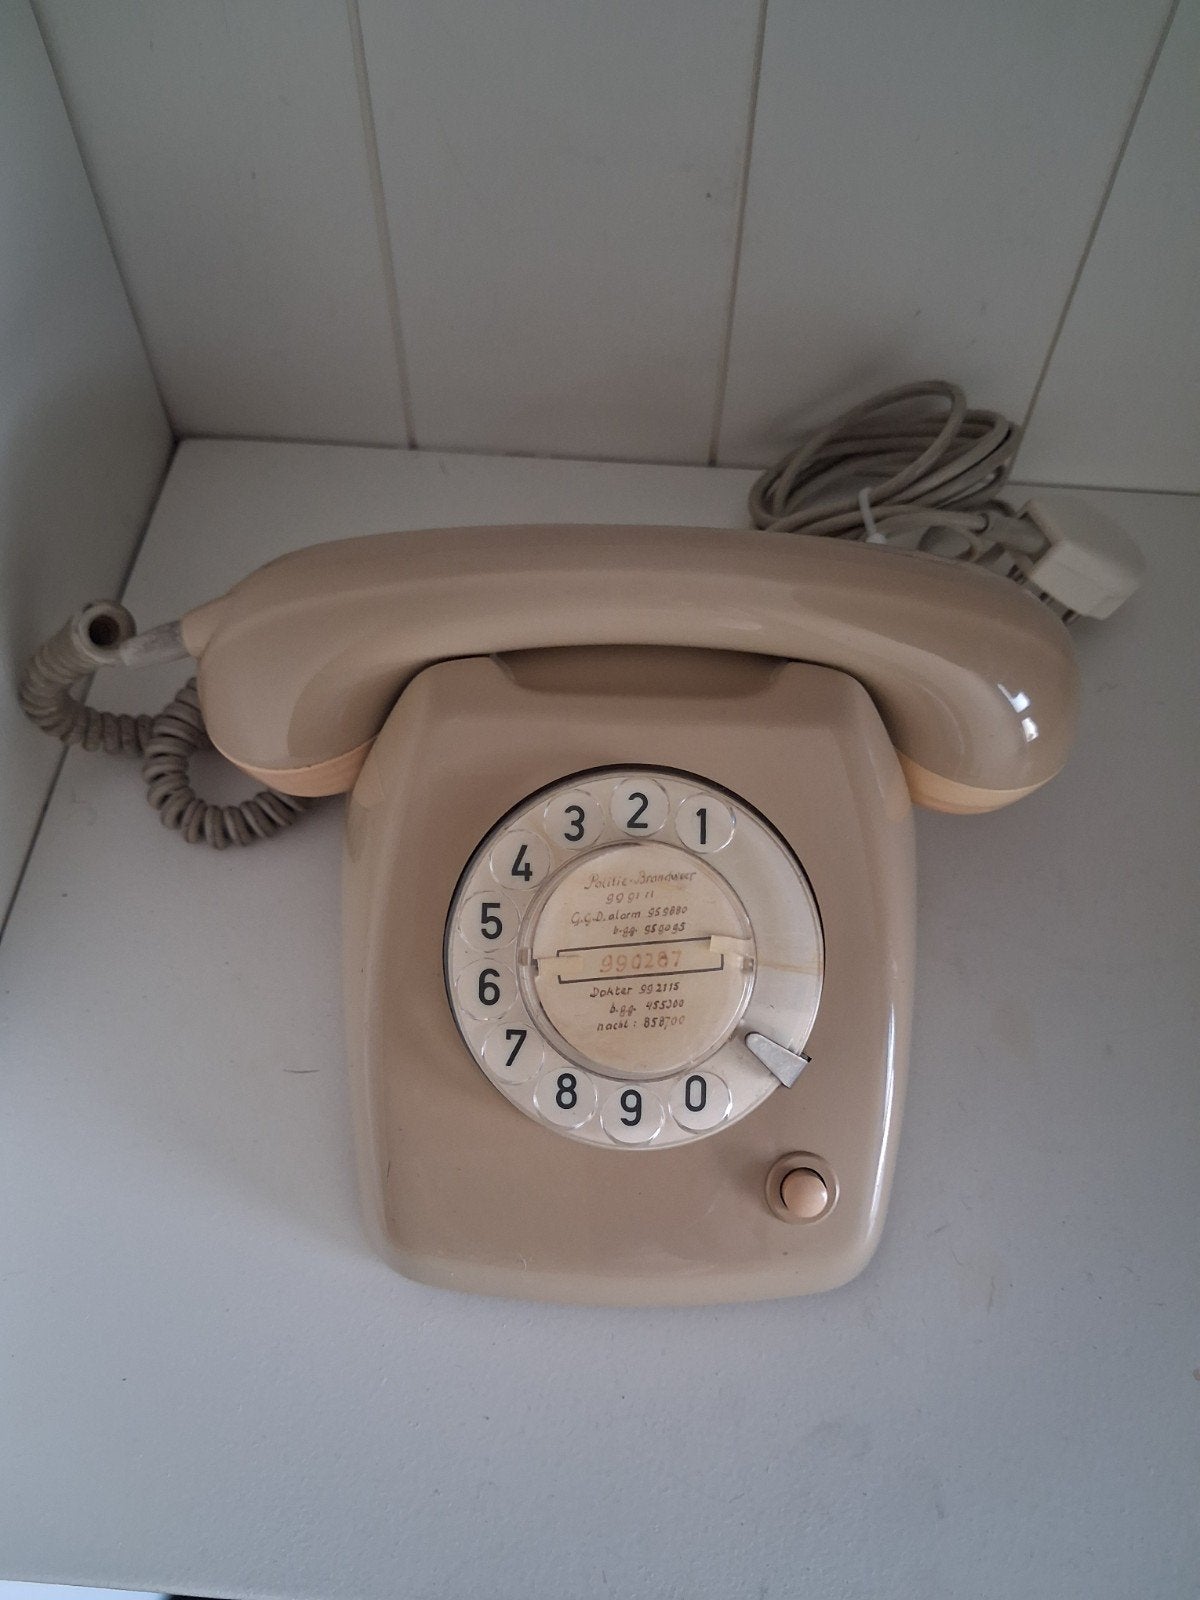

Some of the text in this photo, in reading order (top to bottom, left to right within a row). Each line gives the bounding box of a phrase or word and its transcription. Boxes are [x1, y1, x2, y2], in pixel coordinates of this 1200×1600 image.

[563, 804, 586, 842] 3
[626, 791, 649, 829] 2
[695, 808, 707, 845] 1
[511, 844, 533, 882] 4
[480, 902, 503, 940] 5
[478, 968, 501, 1006] 6
[589, 981, 681, 998] Dokter 992115
[505, 1028, 528, 1067] 7
[555, 1072, 578, 1110] 8
[620, 1089, 642, 1127] 9
[685, 1074, 707, 1113] 0
